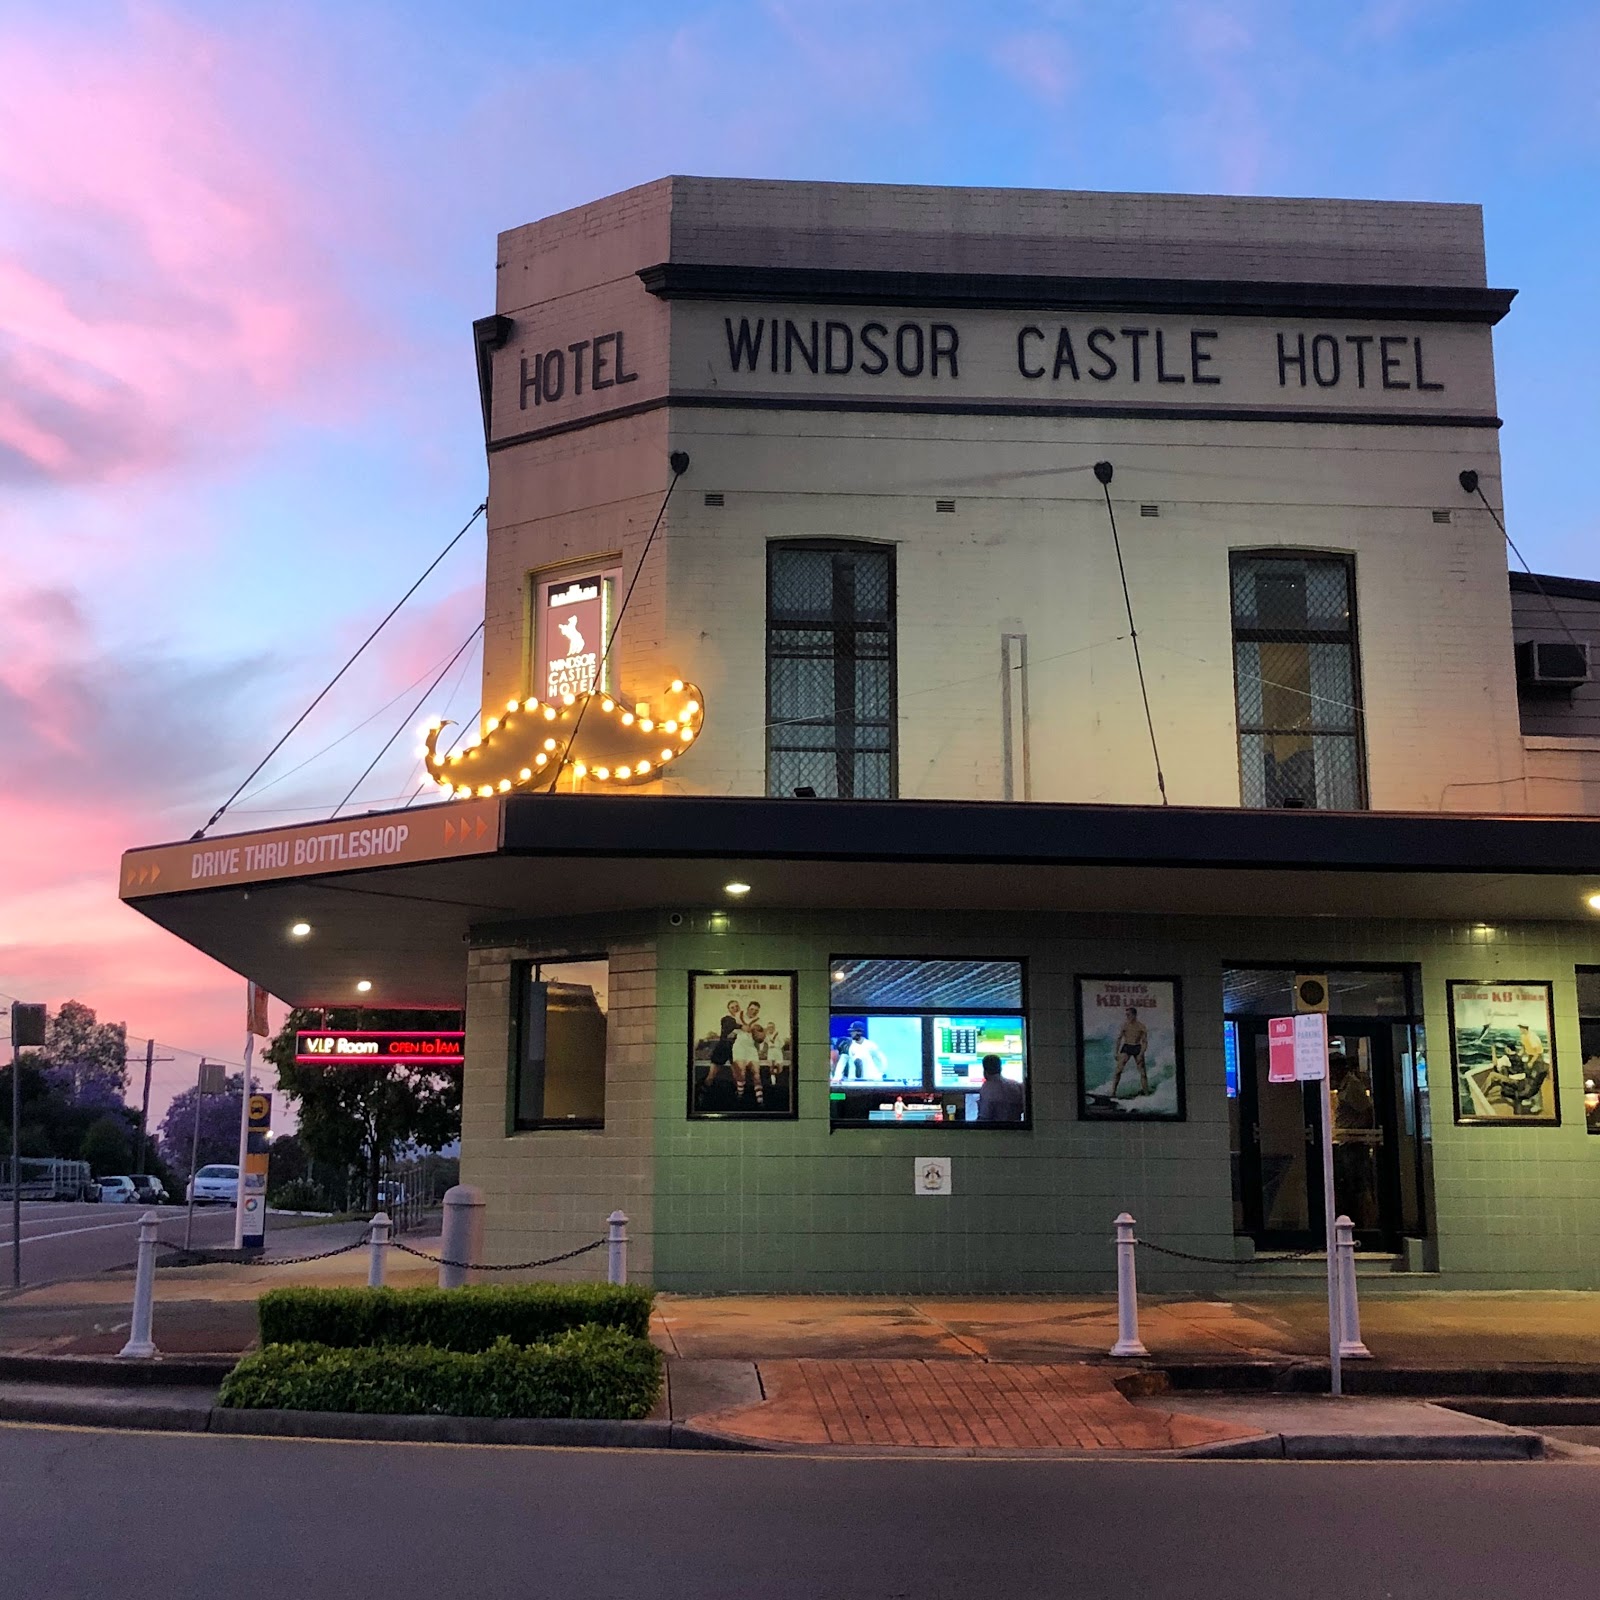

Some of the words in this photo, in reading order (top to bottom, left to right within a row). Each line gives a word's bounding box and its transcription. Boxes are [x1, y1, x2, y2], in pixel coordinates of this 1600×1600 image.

[725, 317, 959, 378] WINDSOR
[1017, 326, 1221, 384] CASTLE
[1276, 333, 1445, 392] HOTEL
[520, 330, 638, 410] HOTEL
[550, 653, 596, 671] WINDSOR
[549, 666, 595, 684] CASTLE
[548, 677, 595, 698] HOTEL
[191, 847, 239, 879] DRIVE
[244, 841, 289, 871] THRU
[293, 824, 409, 866] BOTTLESHOP
[1276, 1023, 1287, 1033] NO
[337, 1037, 379, 1054] Room
[389, 1041, 419, 1053] OPEN
[422, 1039, 434, 1053] to
